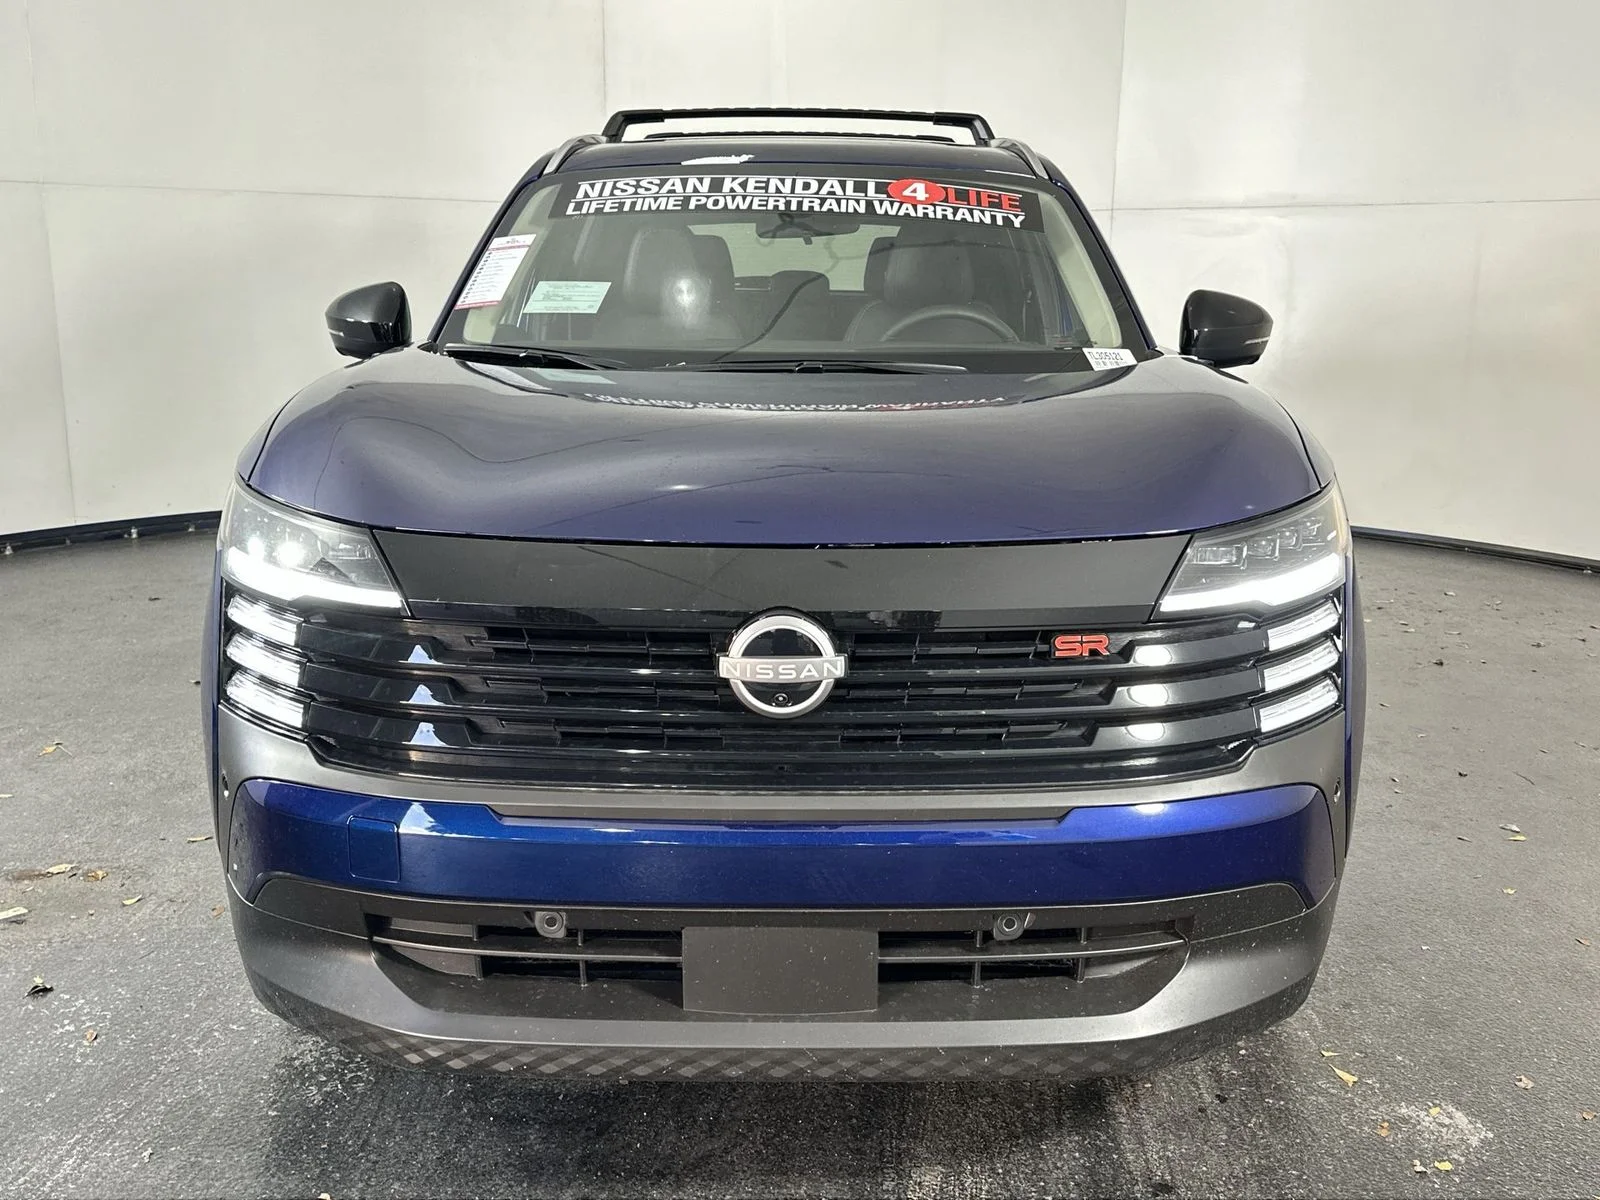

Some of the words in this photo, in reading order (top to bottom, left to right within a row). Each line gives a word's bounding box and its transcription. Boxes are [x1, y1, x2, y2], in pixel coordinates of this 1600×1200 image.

[575, 177, 711, 199] NISSAN
[722, 176, 887, 198] KENDALL
[902, 182, 929, 201] 4
[948, 187, 1022, 212] LIFE
[565, 196, 683, 216] LIFETIME
[688, 195, 866, 213] POWERTRAIN
[873, 200, 1026, 228] WARRANTY
[1054, 633, 1110, 657] SR
[722, 660, 842, 679] NISSAN
